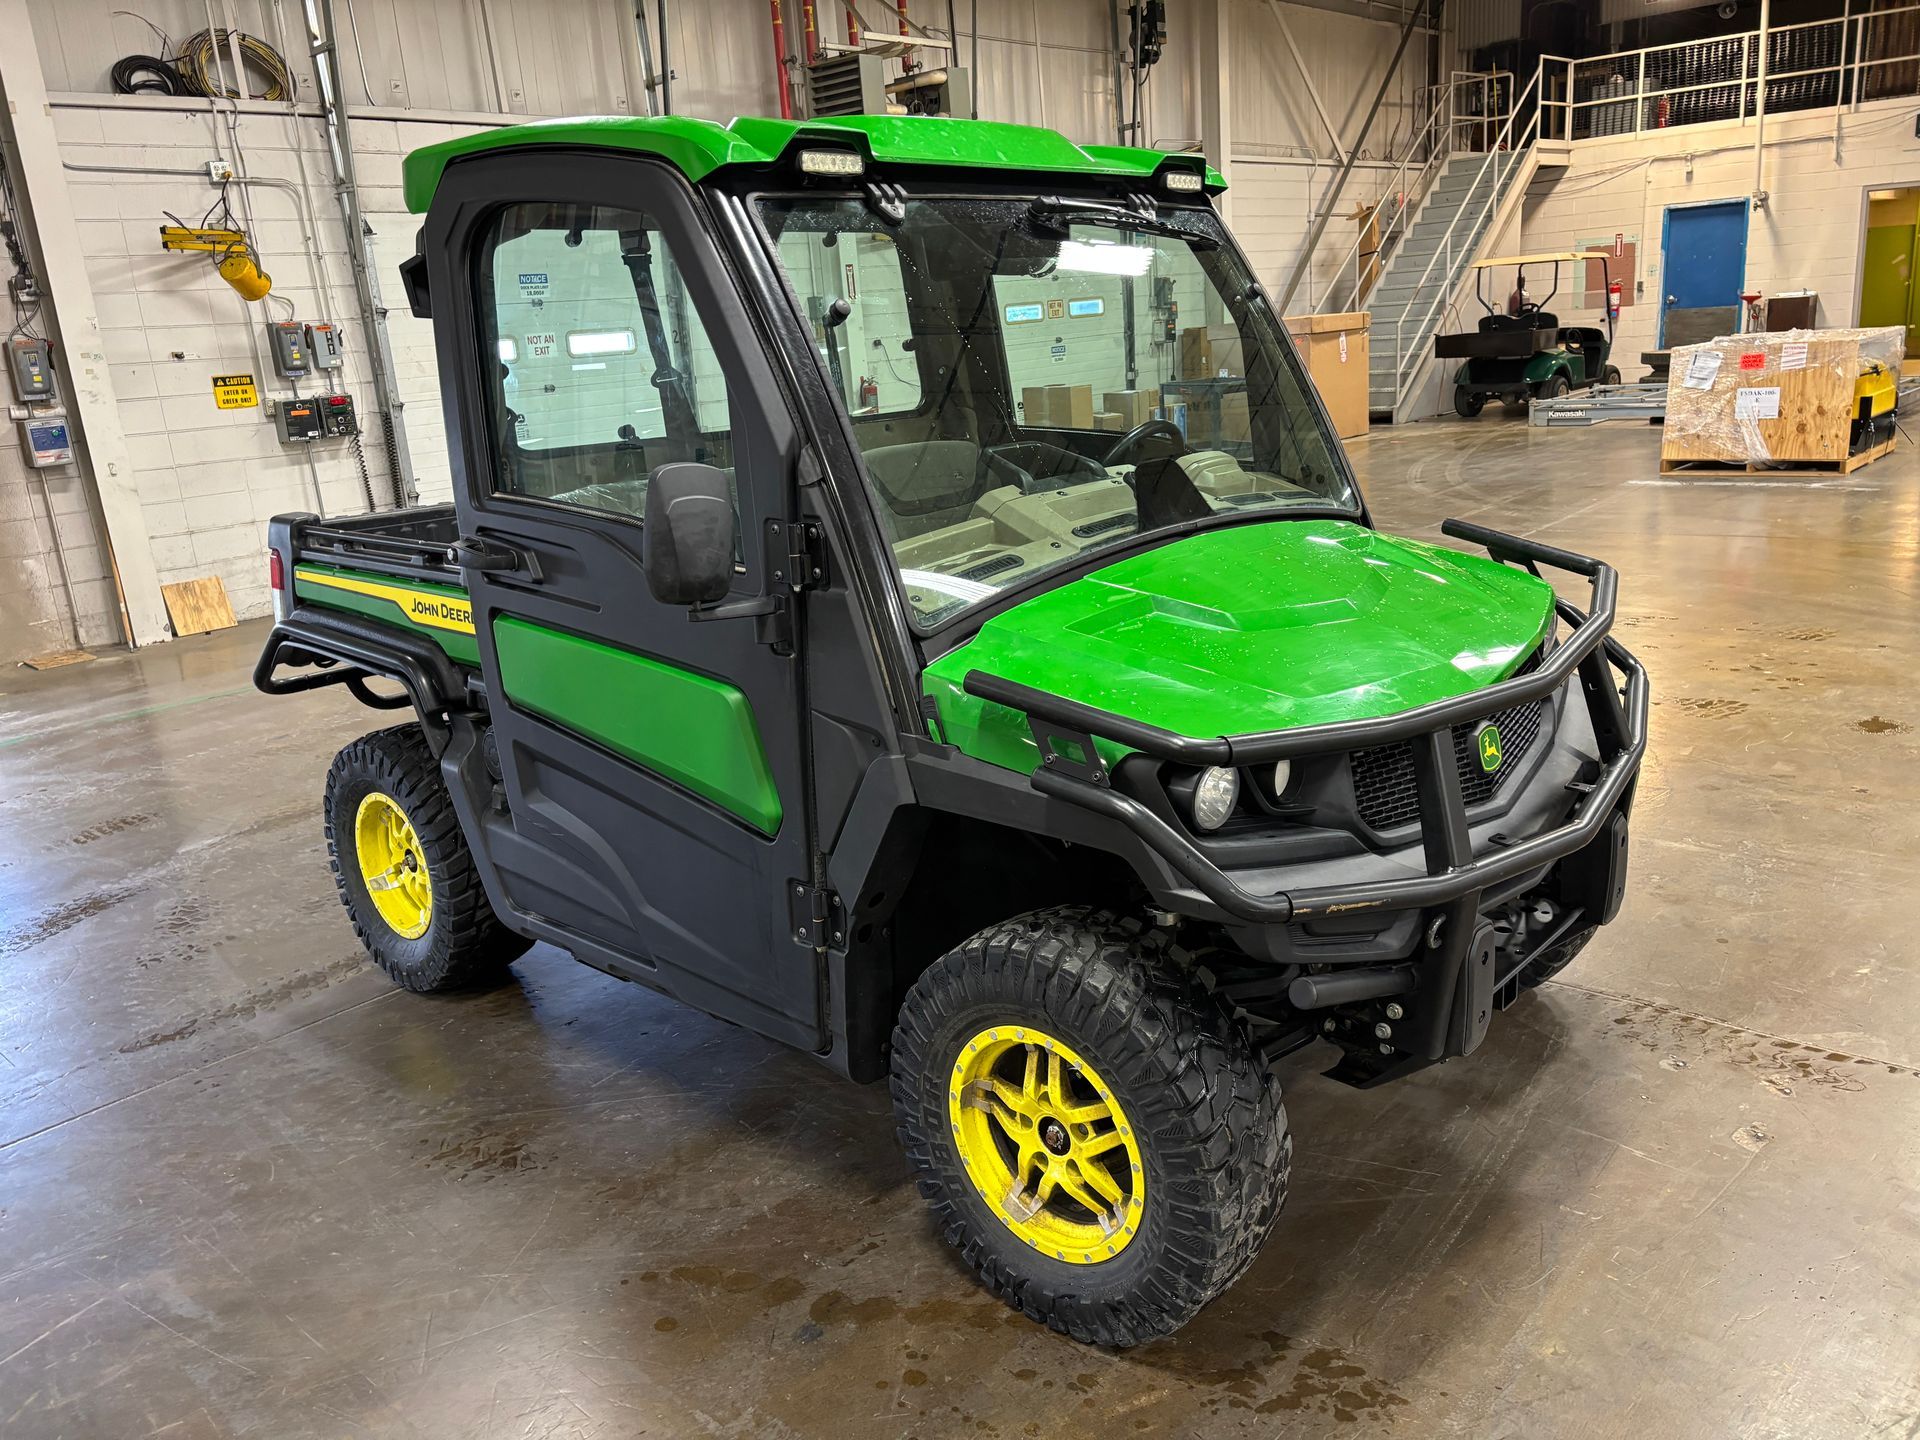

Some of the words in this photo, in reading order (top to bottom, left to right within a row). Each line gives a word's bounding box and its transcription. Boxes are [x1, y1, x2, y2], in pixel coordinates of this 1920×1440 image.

[520, 275, 547, 283] NOTICE
[527, 335, 542, 345] NOT
[544, 334, 555, 344] AN
[534, 346, 550, 356] EXIT
[226, 377, 250, 385] CAUTION
[1548, 409, 1586, 417] Kawasaki
[411, 598, 439, 617] JOHN
